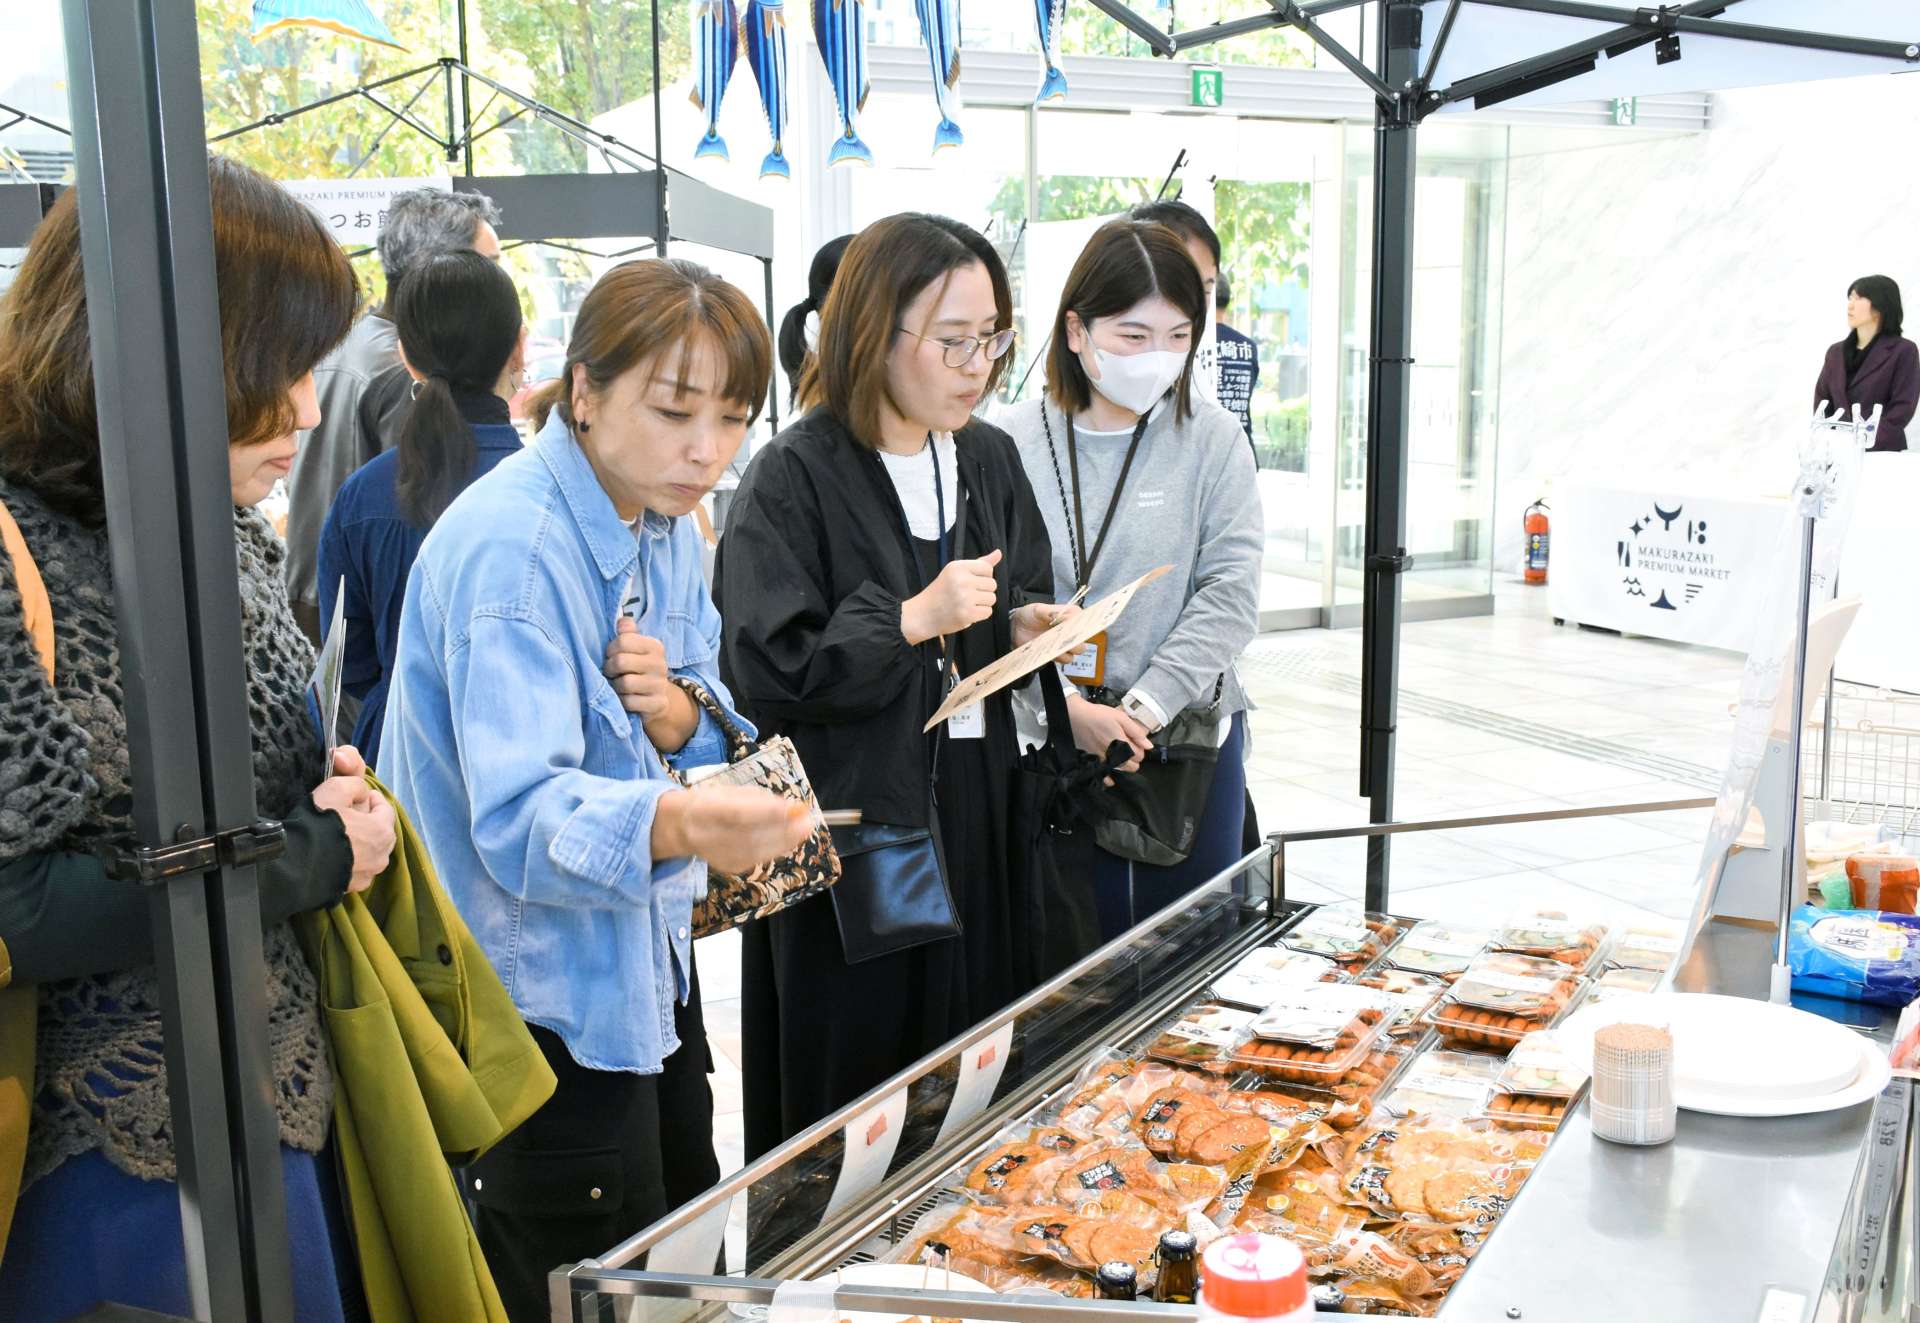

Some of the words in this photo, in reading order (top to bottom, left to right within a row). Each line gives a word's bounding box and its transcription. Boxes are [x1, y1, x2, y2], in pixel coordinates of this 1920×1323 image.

[295, 191, 335, 201] RAZAKI
[337, 191, 386, 200] PREMIUM
[1638, 546, 1714, 564] MAKURAZAKI
[1637, 559, 1685, 574] PREMIUM
[1689, 567, 1731, 580] MARKET
